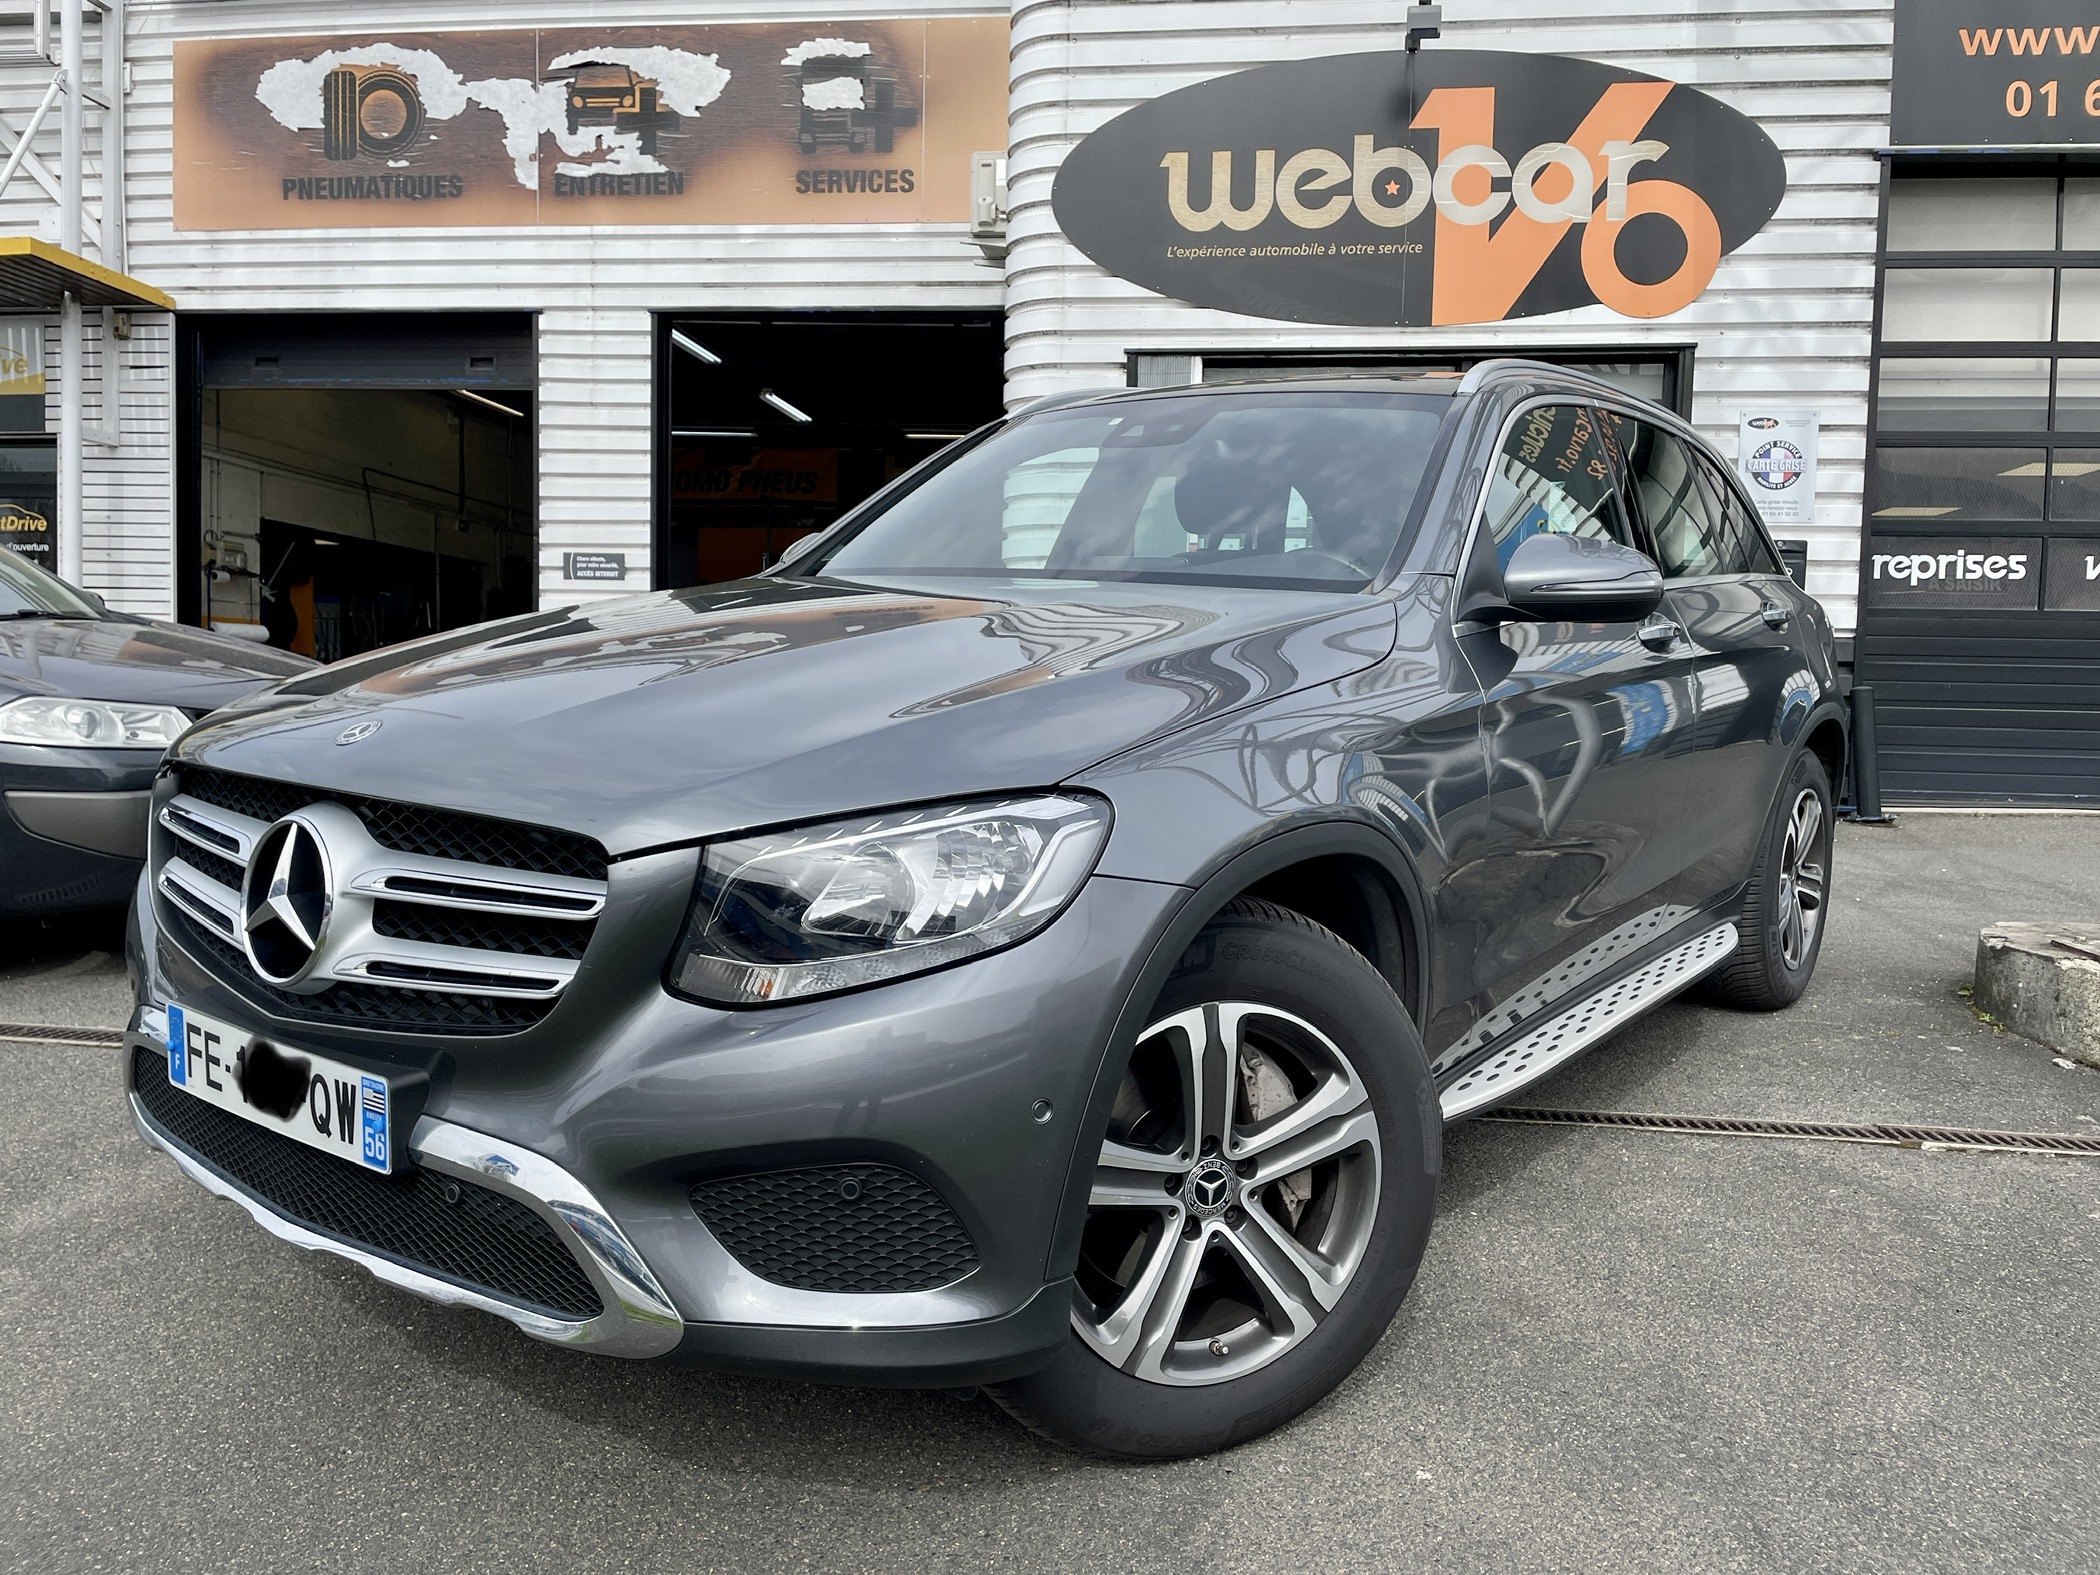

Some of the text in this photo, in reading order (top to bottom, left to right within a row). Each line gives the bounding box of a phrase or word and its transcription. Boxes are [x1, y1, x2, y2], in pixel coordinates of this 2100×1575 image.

[2005, 80, 2058, 118] 01
[282, 174, 463, 201] PNEUMATIQUES
[554, 171, 684, 196] ENTRETIEN
[796, 169, 915, 194] SERVICES
[1159, 133, 1671, 232] webcar
[1249, 243, 1325, 257] automobile
[1328, 242, 1336, 255] à
[1340, 243, 1375, 255] votre
[1378, 241, 1423, 254] service
[1754, 440, 1802, 459] POINT SERVICE
[1747, 459, 1806, 472] CARTE GRISE
[671, 470, 819, 494] OMO PNEUS
[576, 569, 619, 578] ACCÈS INTERDIT
[1871, 548, 2028, 587] reprises
[174, 1053, 181, 1070] F
[364, 1126, 386, 1161] 56
